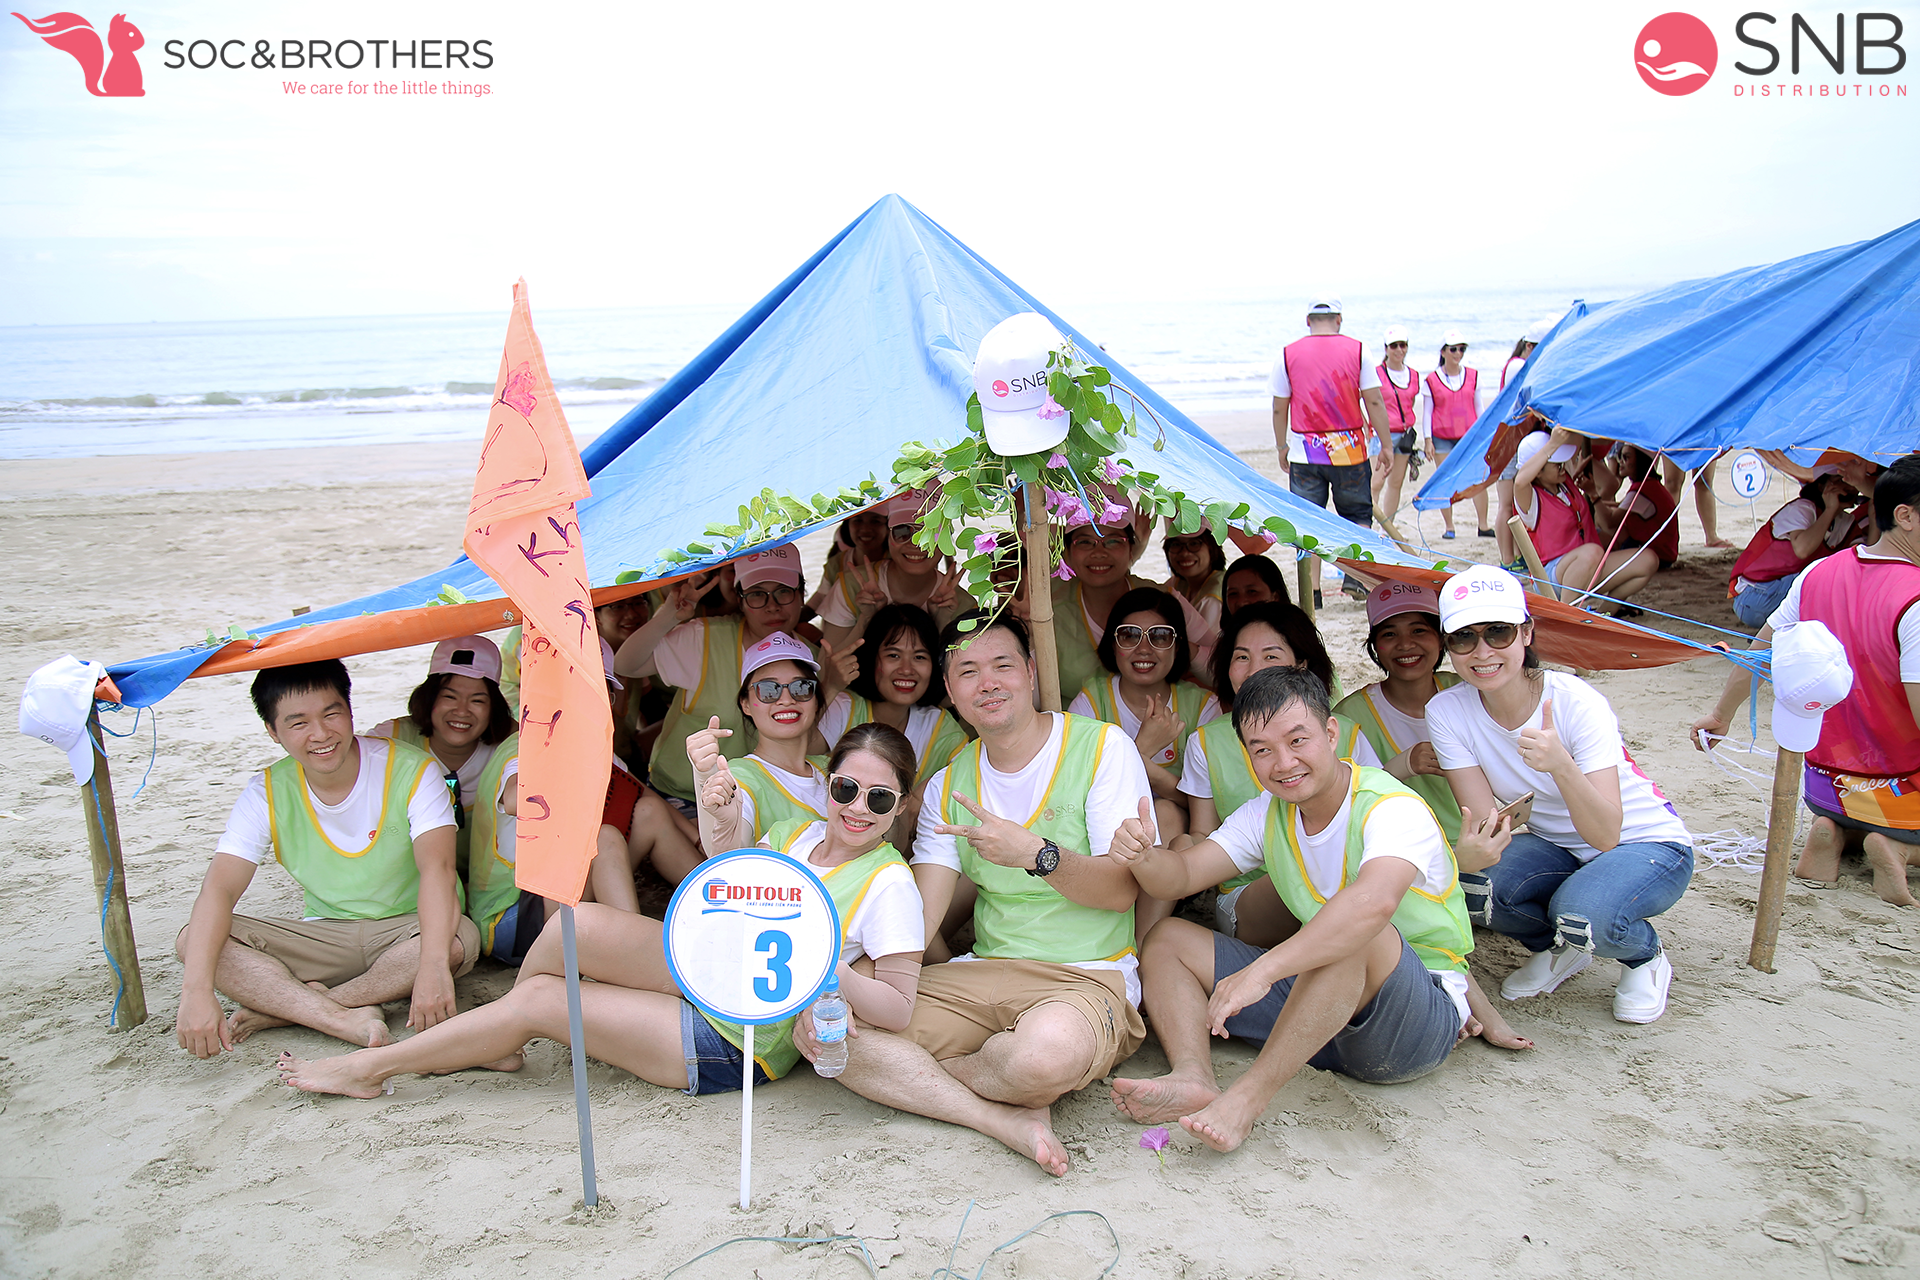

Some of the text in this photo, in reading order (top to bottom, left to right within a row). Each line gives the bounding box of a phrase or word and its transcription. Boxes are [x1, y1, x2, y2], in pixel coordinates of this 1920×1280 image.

[1010, 370, 1046, 393] SNB
[1744, 473, 1756, 493] 2
[761, 549, 788, 559] SNB
[1392, 584, 1422, 595] SNB
[1470, 580, 1505, 593] SNB
[772, 636, 802, 650] SNB
[709, 884, 802, 902] FIDITOUR
[753, 929, 793, 1003] 3
